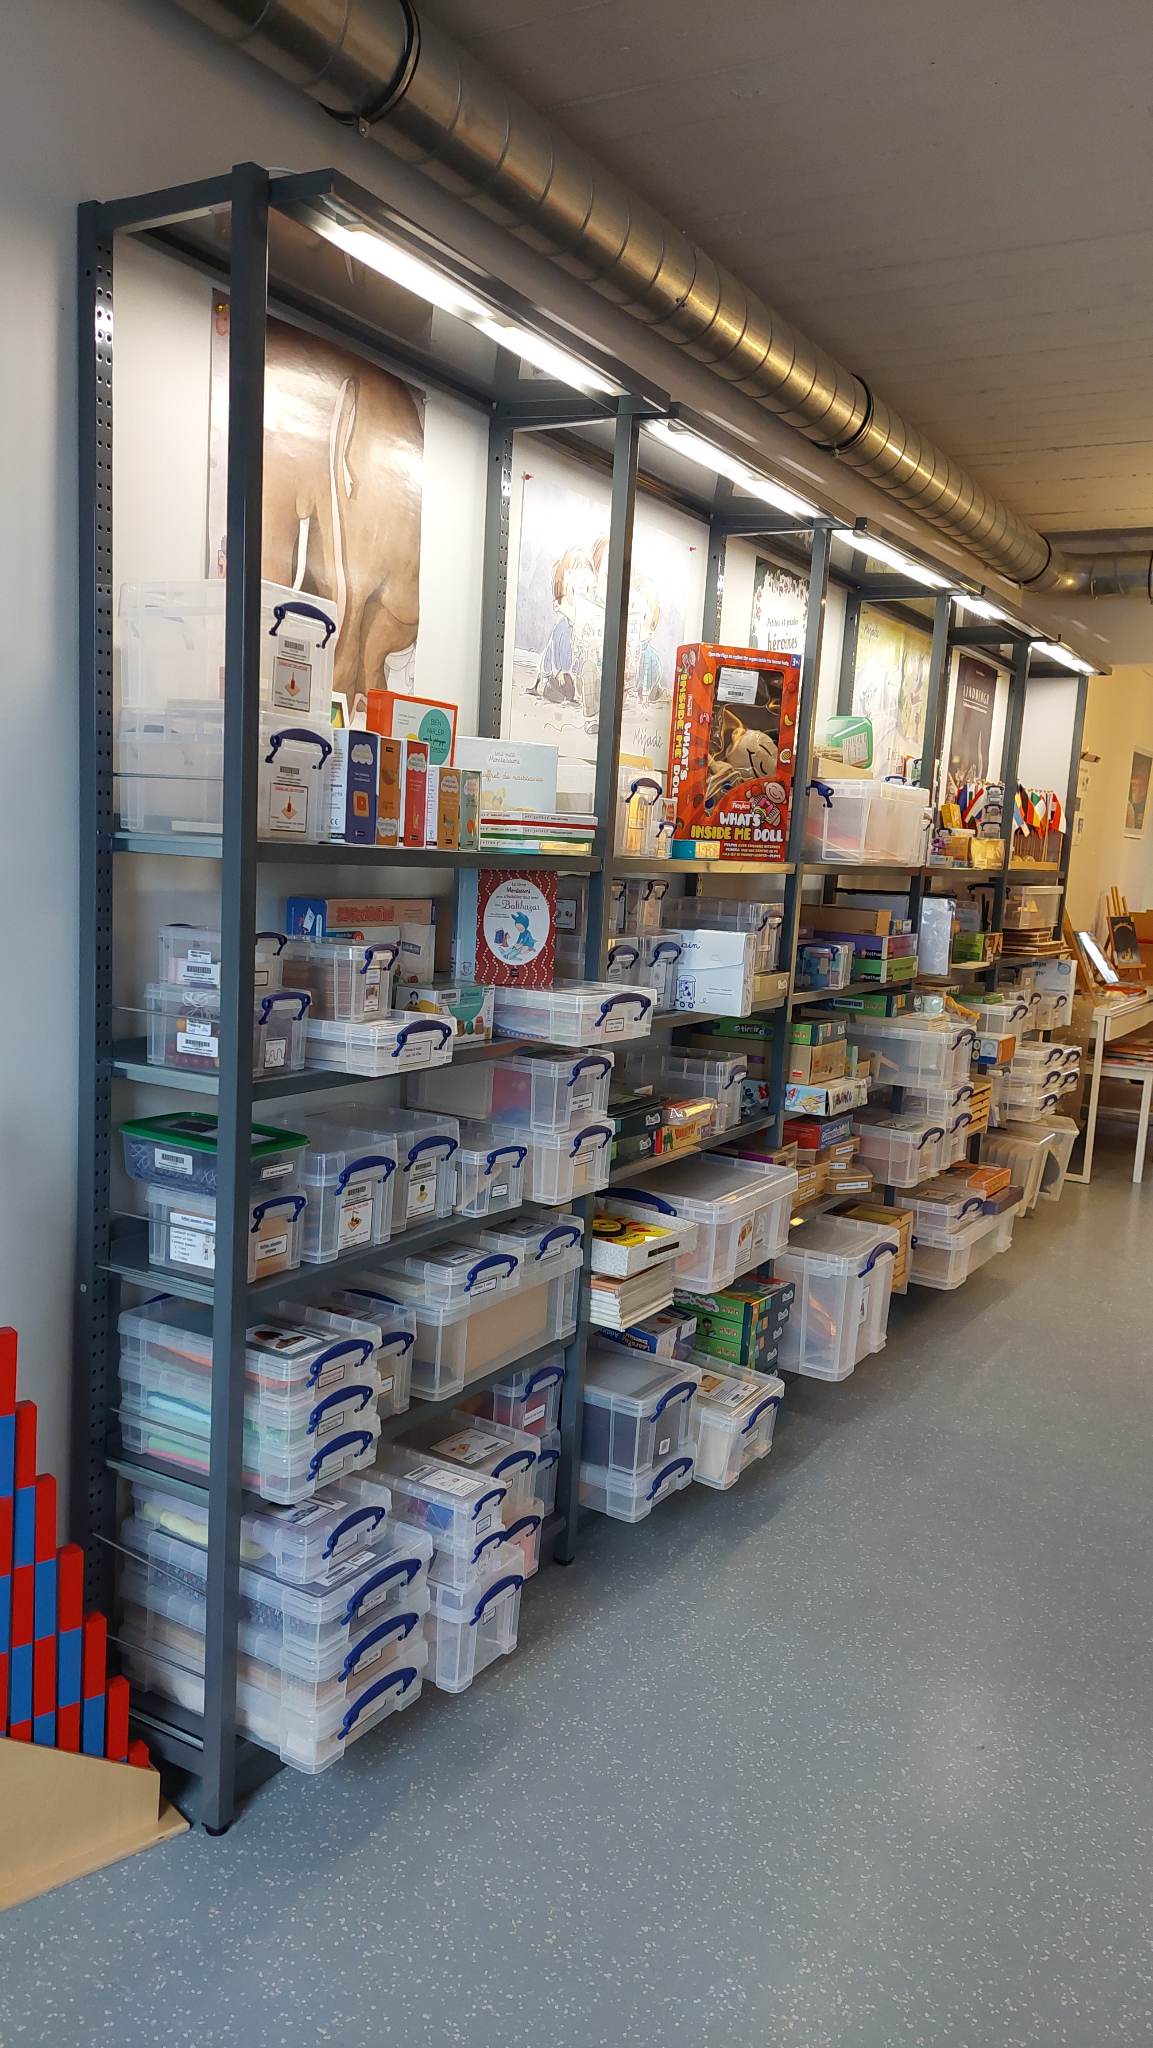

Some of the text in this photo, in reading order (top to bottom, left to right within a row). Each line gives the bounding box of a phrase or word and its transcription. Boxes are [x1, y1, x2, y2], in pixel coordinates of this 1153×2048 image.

[671, 672, 688, 799] INSIDE ME DOL
[680, 721, 692, 781] WHAT'S
[690, 825, 784, 843] INSIDE ME DOLL
[719, 811, 761, 827] WHAT'S
